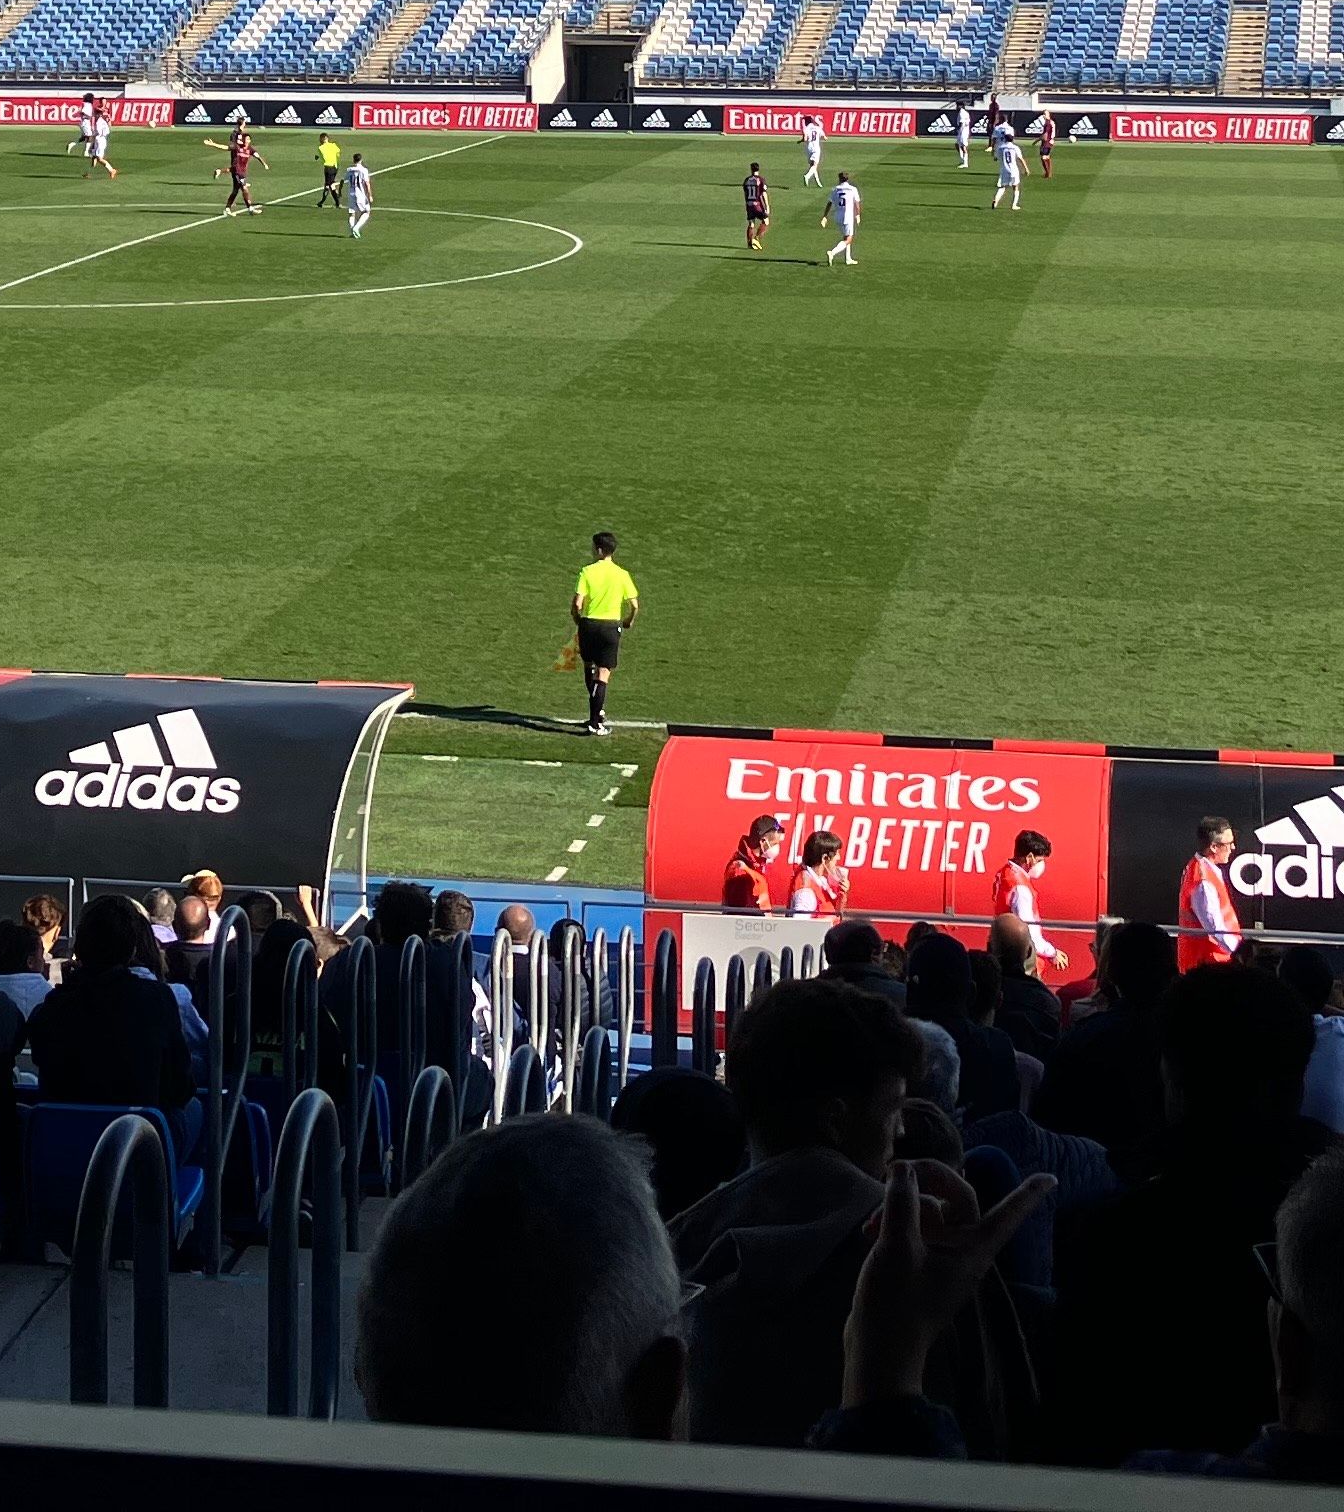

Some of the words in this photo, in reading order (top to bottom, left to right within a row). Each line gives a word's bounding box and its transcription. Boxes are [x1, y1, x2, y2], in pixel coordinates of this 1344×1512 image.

[0, 100, 80, 121] Emirate
[121, 101, 171, 123] BETTER
[359, 104, 450, 126] Emirates
[458, 106, 482, 126] FLY
[484, 106, 535, 128] BETTER
[832, 111, 855, 131] FLY
[859, 112, 912, 133] BETTER
[1116, 115, 1217, 138] Emirates
[1226, 117, 1253, 139] FLY
[1255, 118, 1310, 141] BETTER
[838, 193, 846, 206] 5
[35, 763, 241, 814] adidas
[726, 757, 1041, 813] Emirates
[845, 816, 991, 874] BETTER
